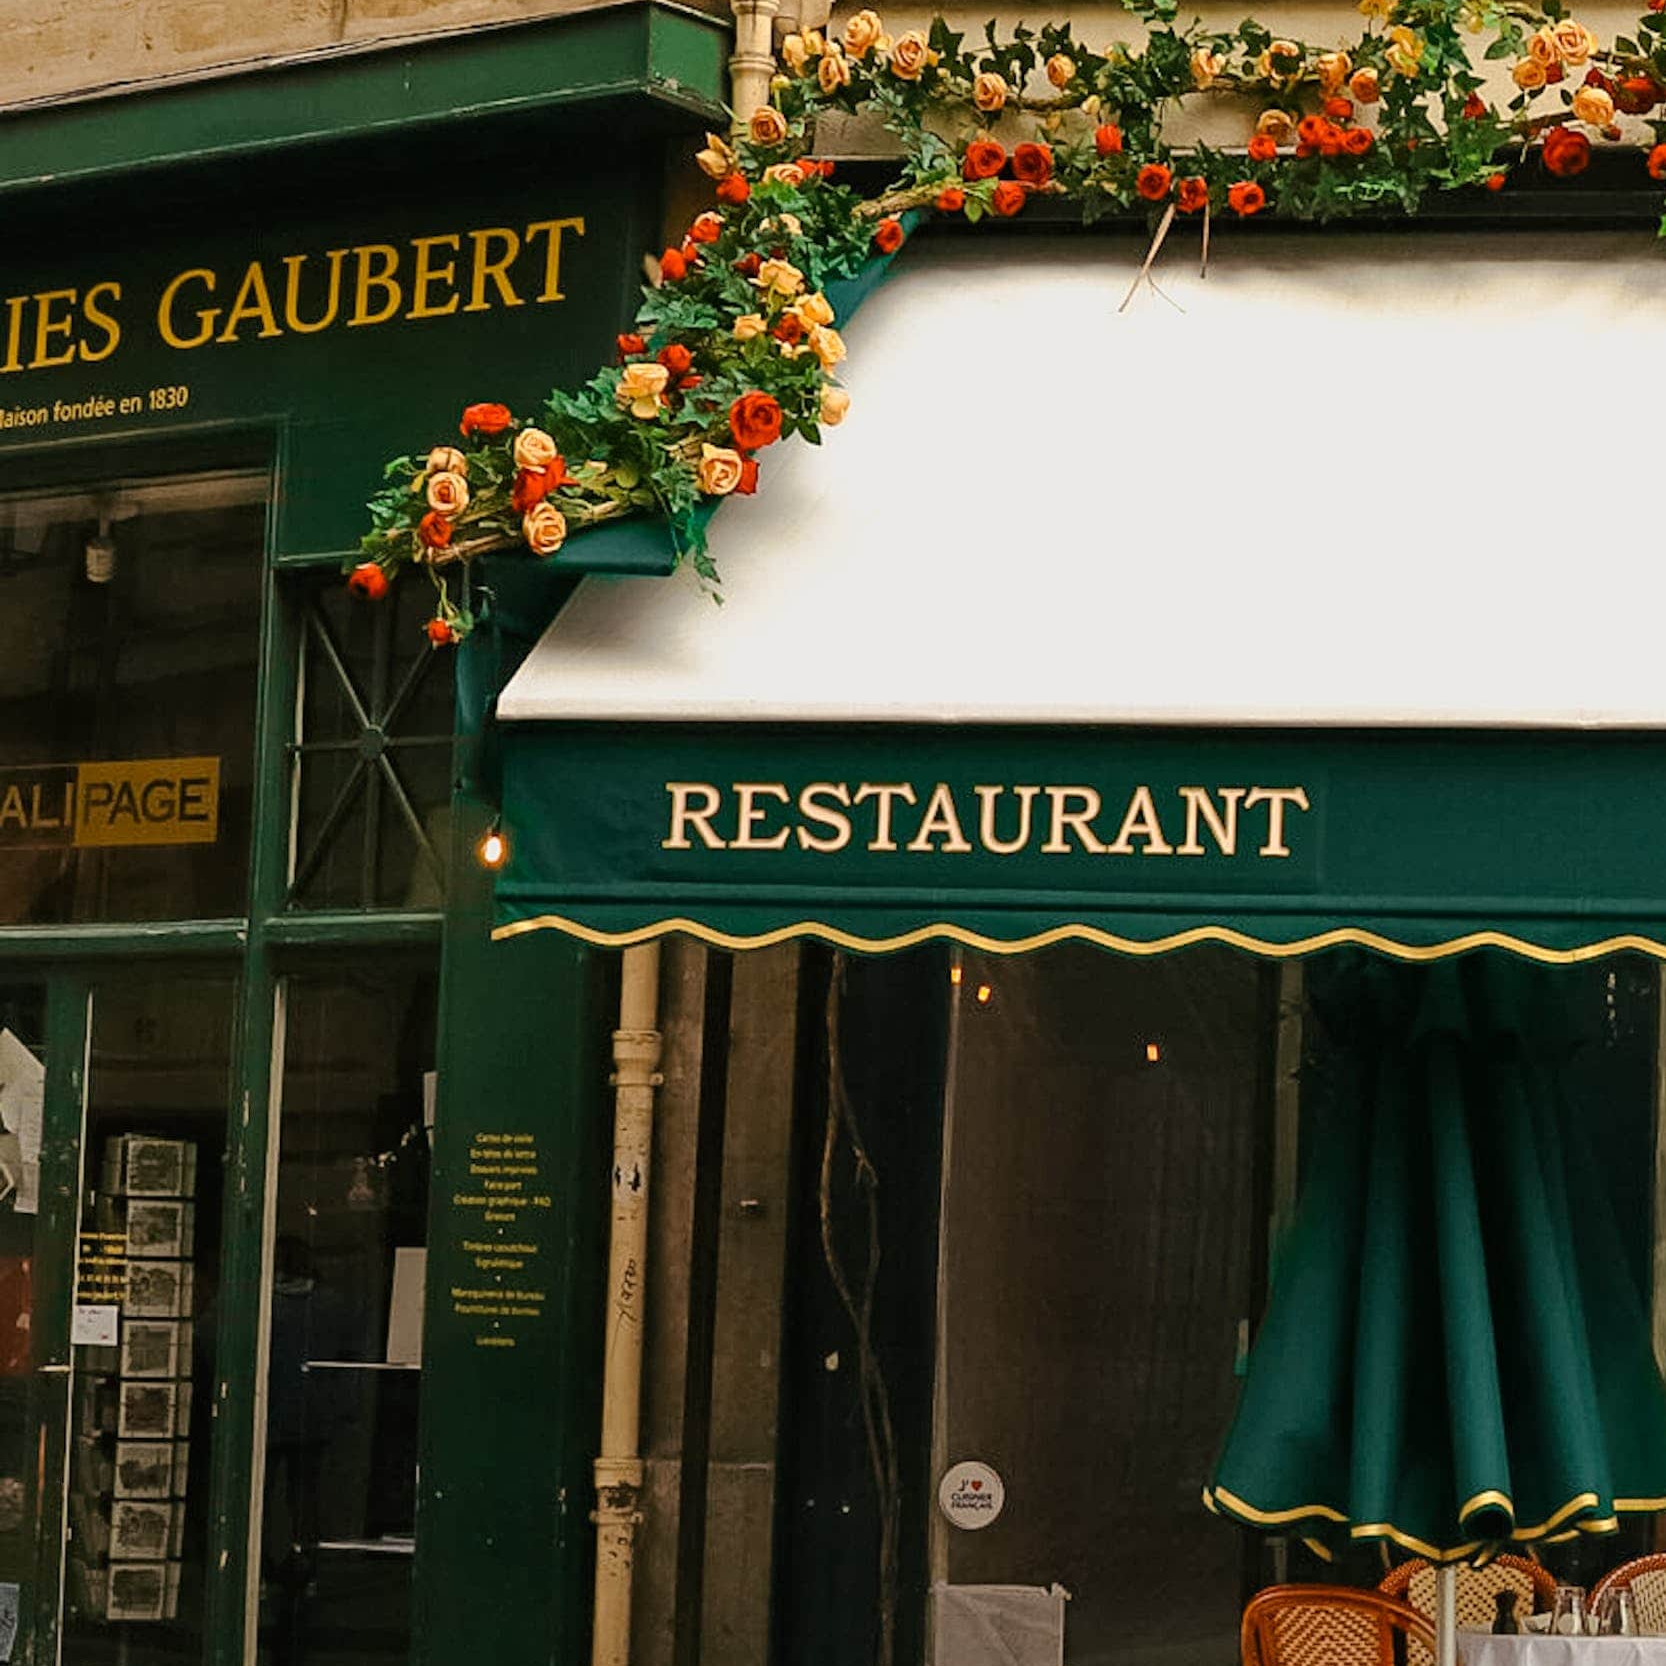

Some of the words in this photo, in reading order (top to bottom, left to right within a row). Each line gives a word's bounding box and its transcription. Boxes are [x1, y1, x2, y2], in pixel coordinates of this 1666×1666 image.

[0, 281, 122, 374] IES
[156, 216, 586, 350] GAUBERT
[53, 393, 116, 423] fondée
[119, 396, 143, 415] en
[149, 385, 189, 411] 1830
[661, 781, 1310, 858] RESTAURANT
